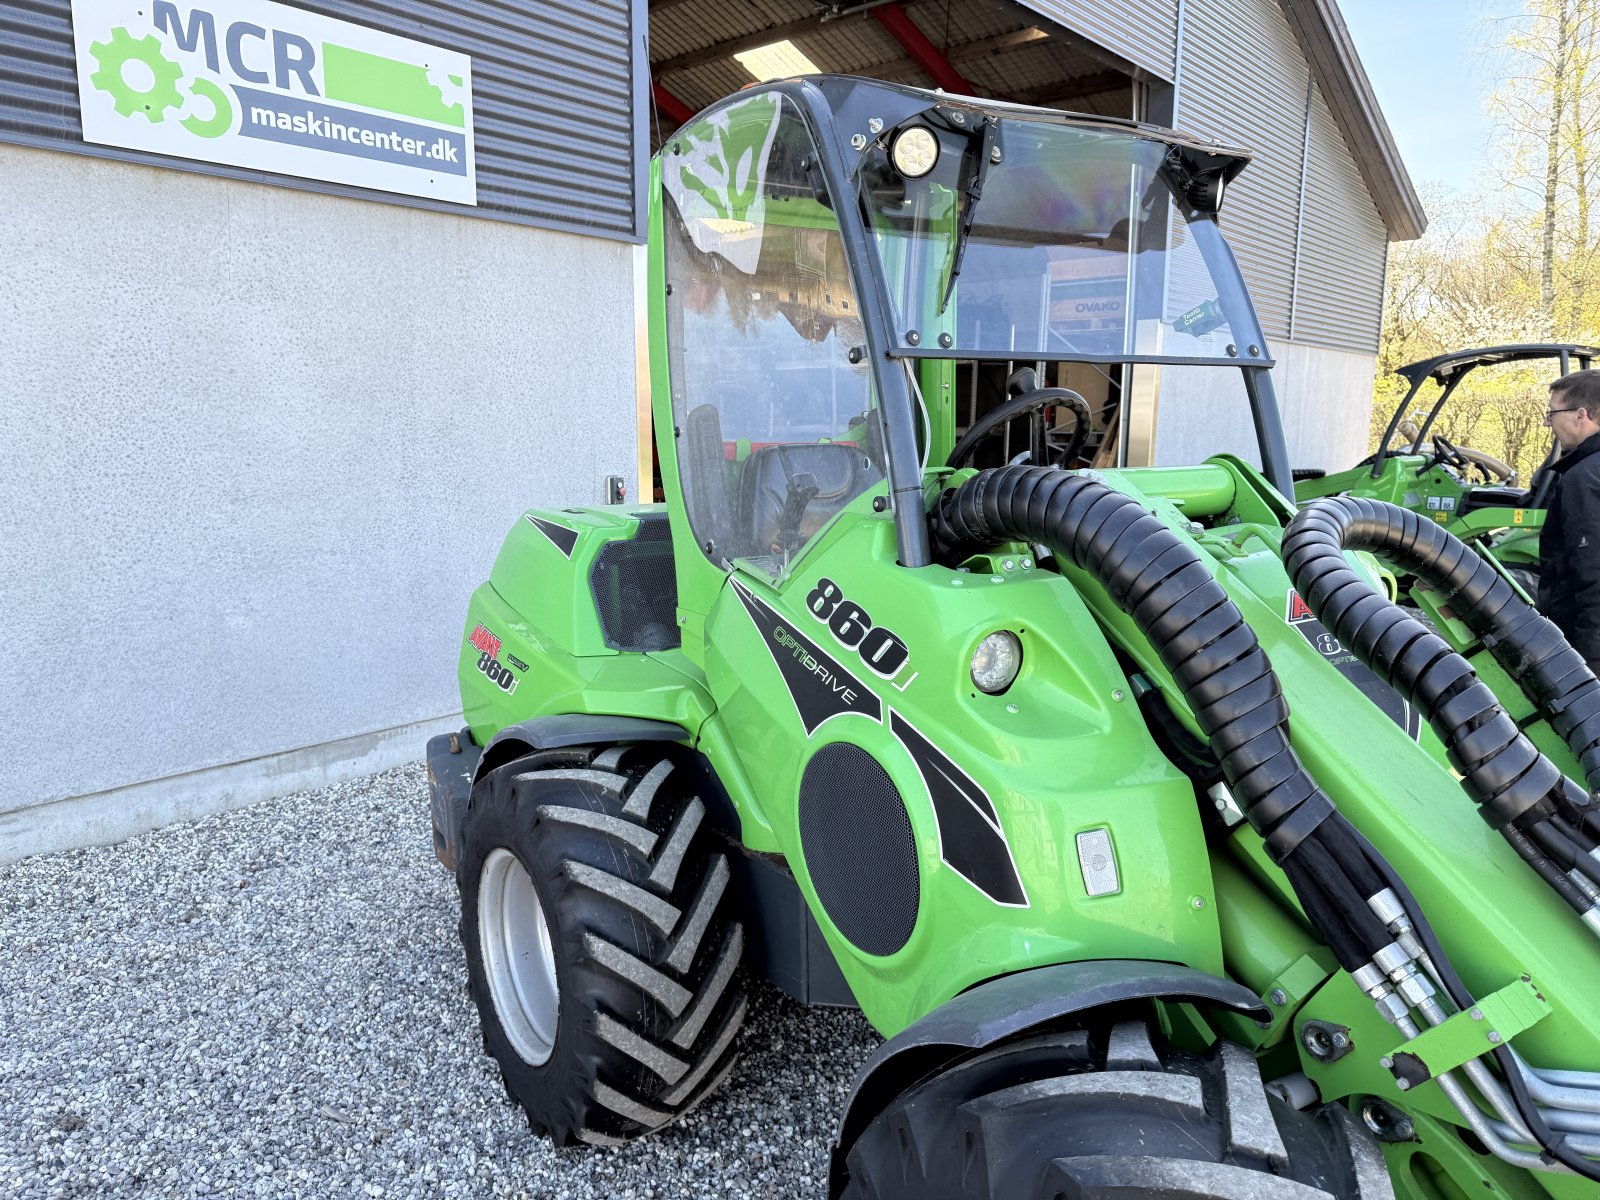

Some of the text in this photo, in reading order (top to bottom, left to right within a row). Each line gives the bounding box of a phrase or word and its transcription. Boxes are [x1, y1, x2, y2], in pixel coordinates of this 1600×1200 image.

[152, 0, 321, 97] MCR
[250, 105, 459, 164] maskincenter.dk
[1075, 301, 1120, 313] OVAKO
[773, 626, 858, 705] OPTIDRIVE
